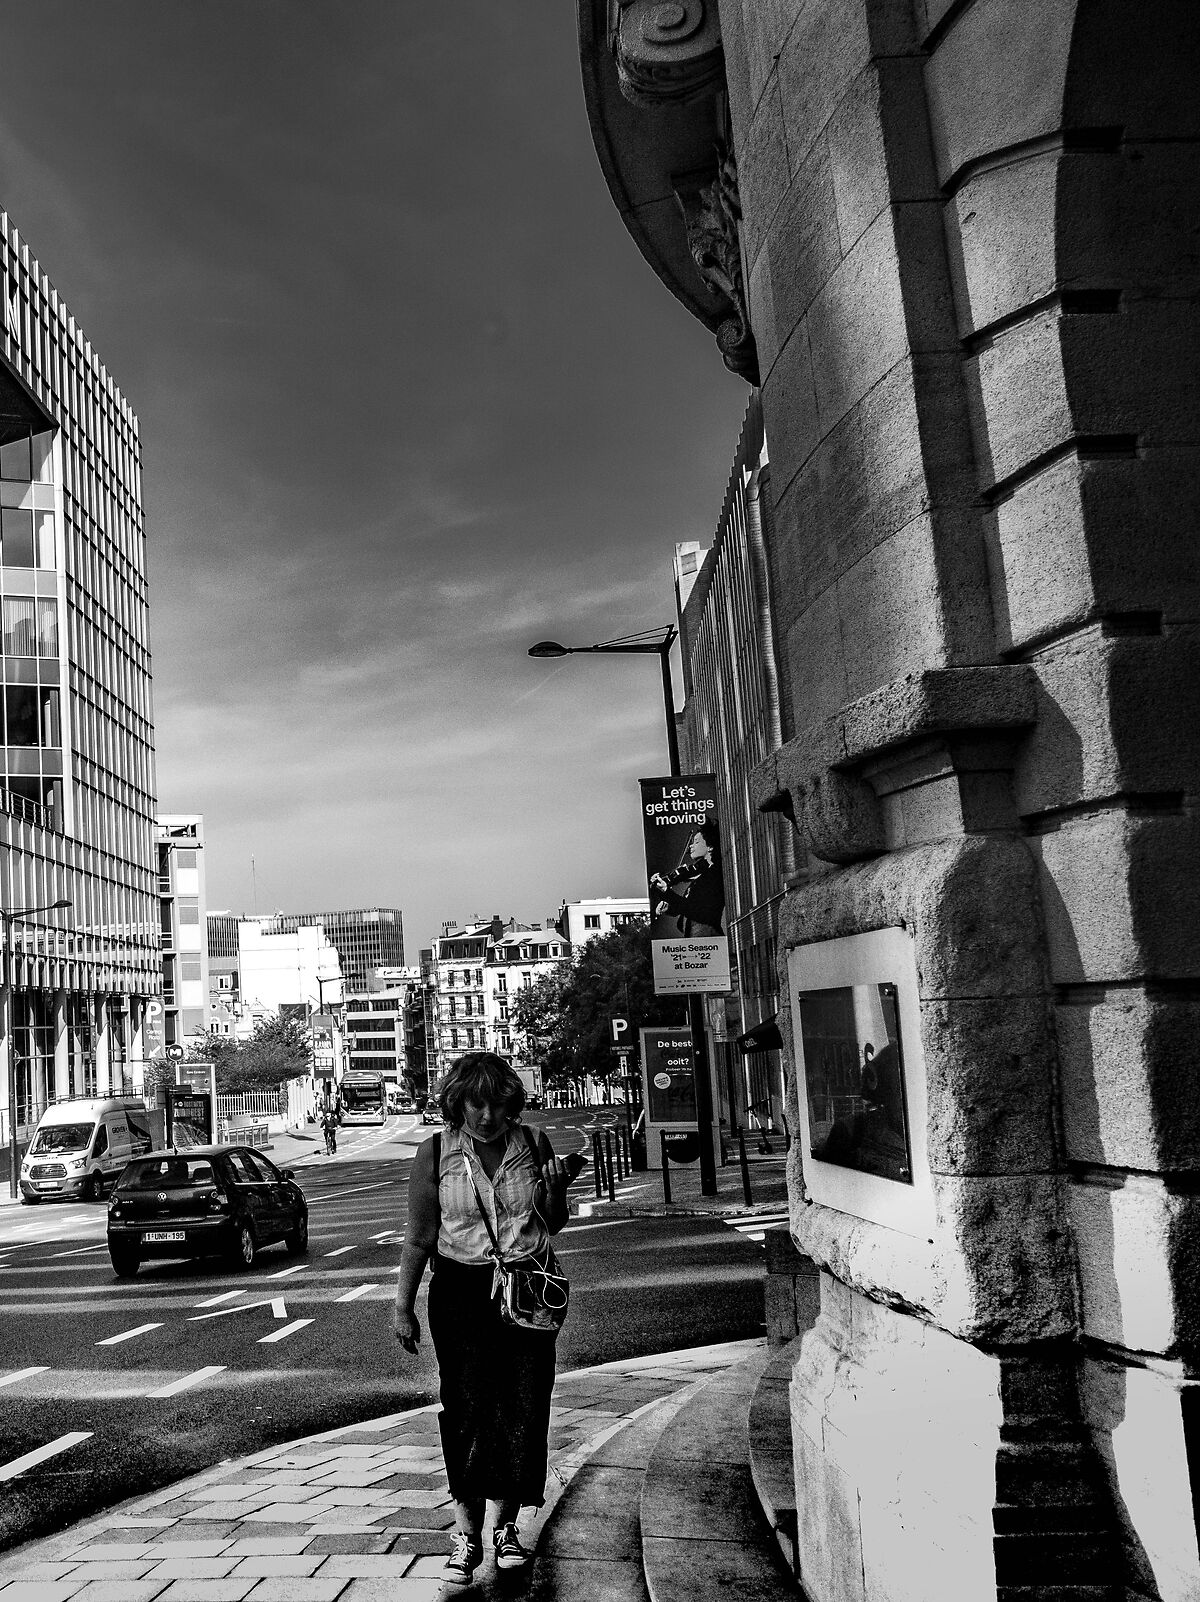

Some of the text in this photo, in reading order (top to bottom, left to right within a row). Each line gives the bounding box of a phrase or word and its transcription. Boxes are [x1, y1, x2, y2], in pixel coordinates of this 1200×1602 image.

[662, 785, 696, 799] Let's
[645, 798, 715, 816] get things
[655, 811, 706, 826] moving
[662, 944, 719, 953] Music Season
[674, 961, 708, 970] at Bozar
[145, 1001, 162, 1024] P
[612, 1018, 628, 1041] P
[657, 1040, 693, 1048] De best
[169, 1048, 182, 1057] M
[667, 1057, 690, 1066] ooit?
